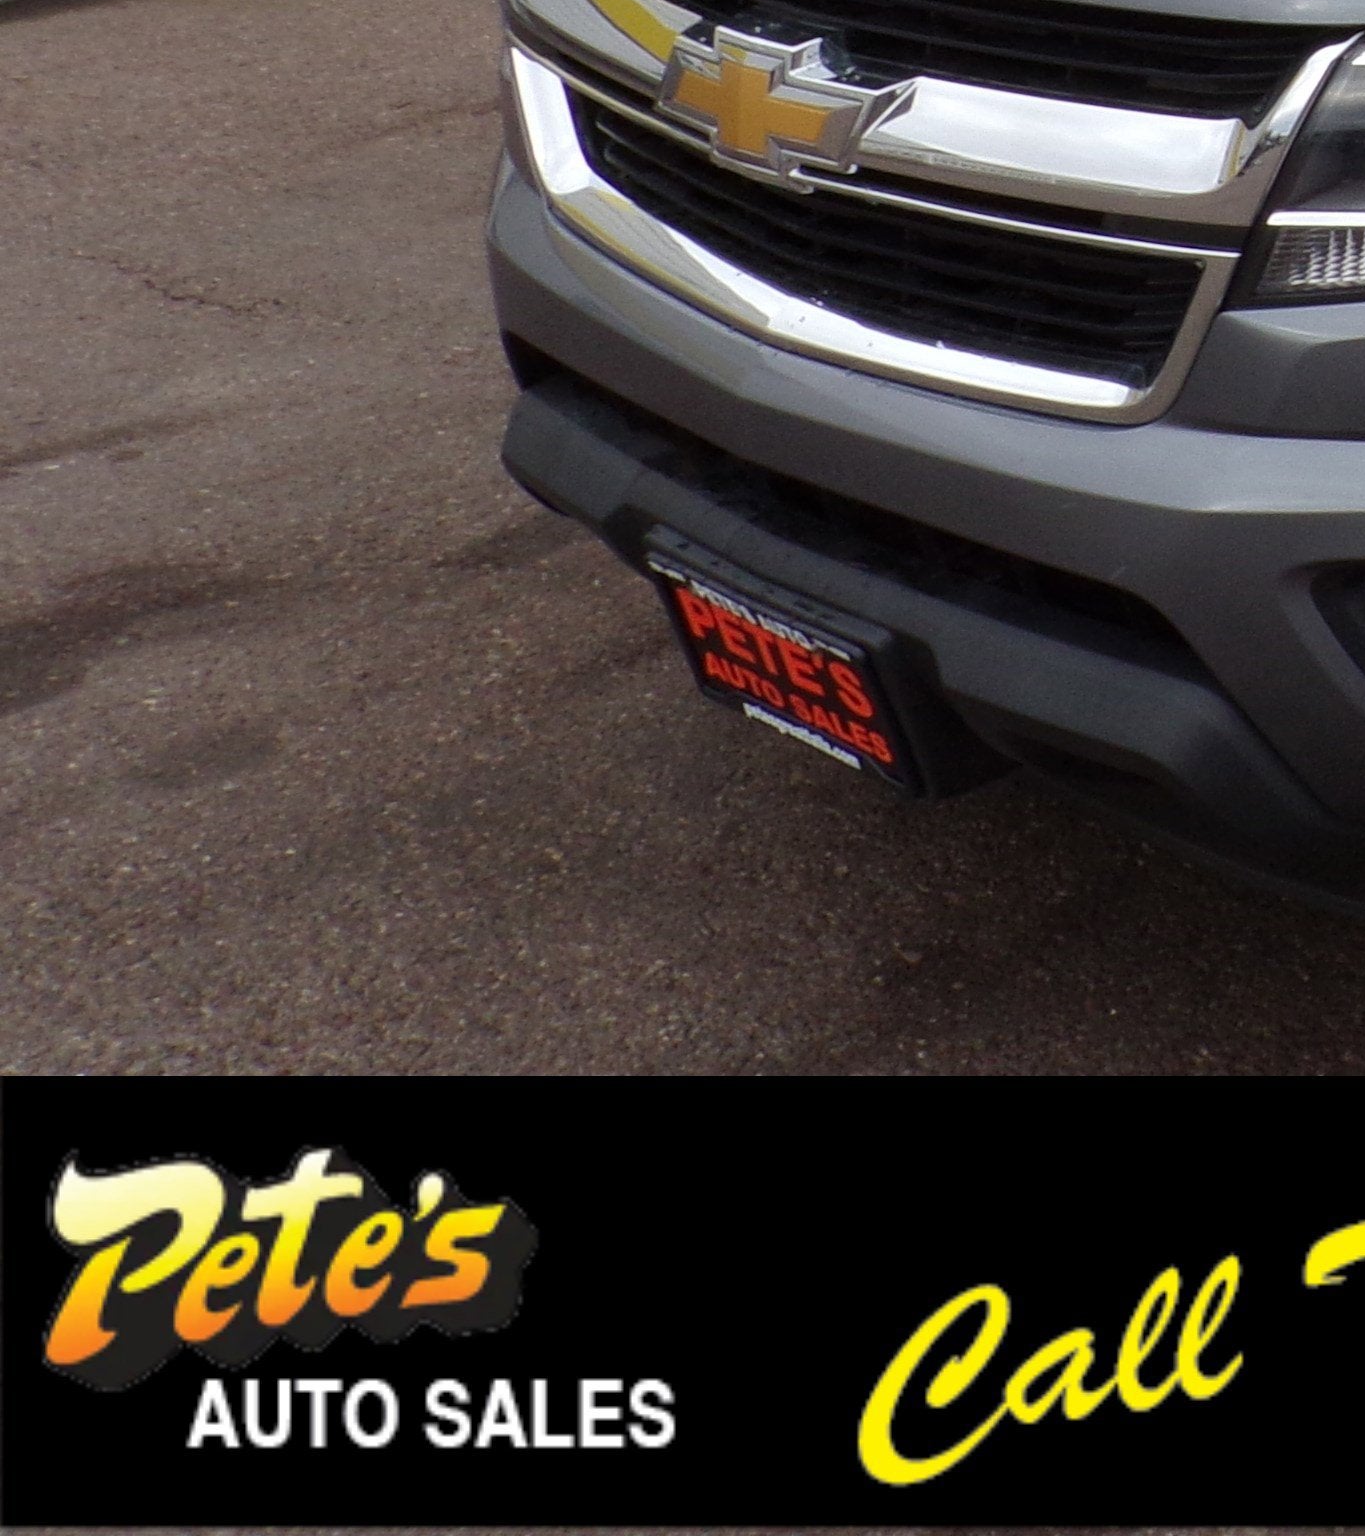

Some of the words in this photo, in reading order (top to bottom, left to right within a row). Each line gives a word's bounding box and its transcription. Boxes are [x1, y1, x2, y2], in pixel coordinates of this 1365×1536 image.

[674, 585, 876, 719] PETE'S
[704, 651, 786, 709] AUTO
[788, 692, 894, 764] SALES
